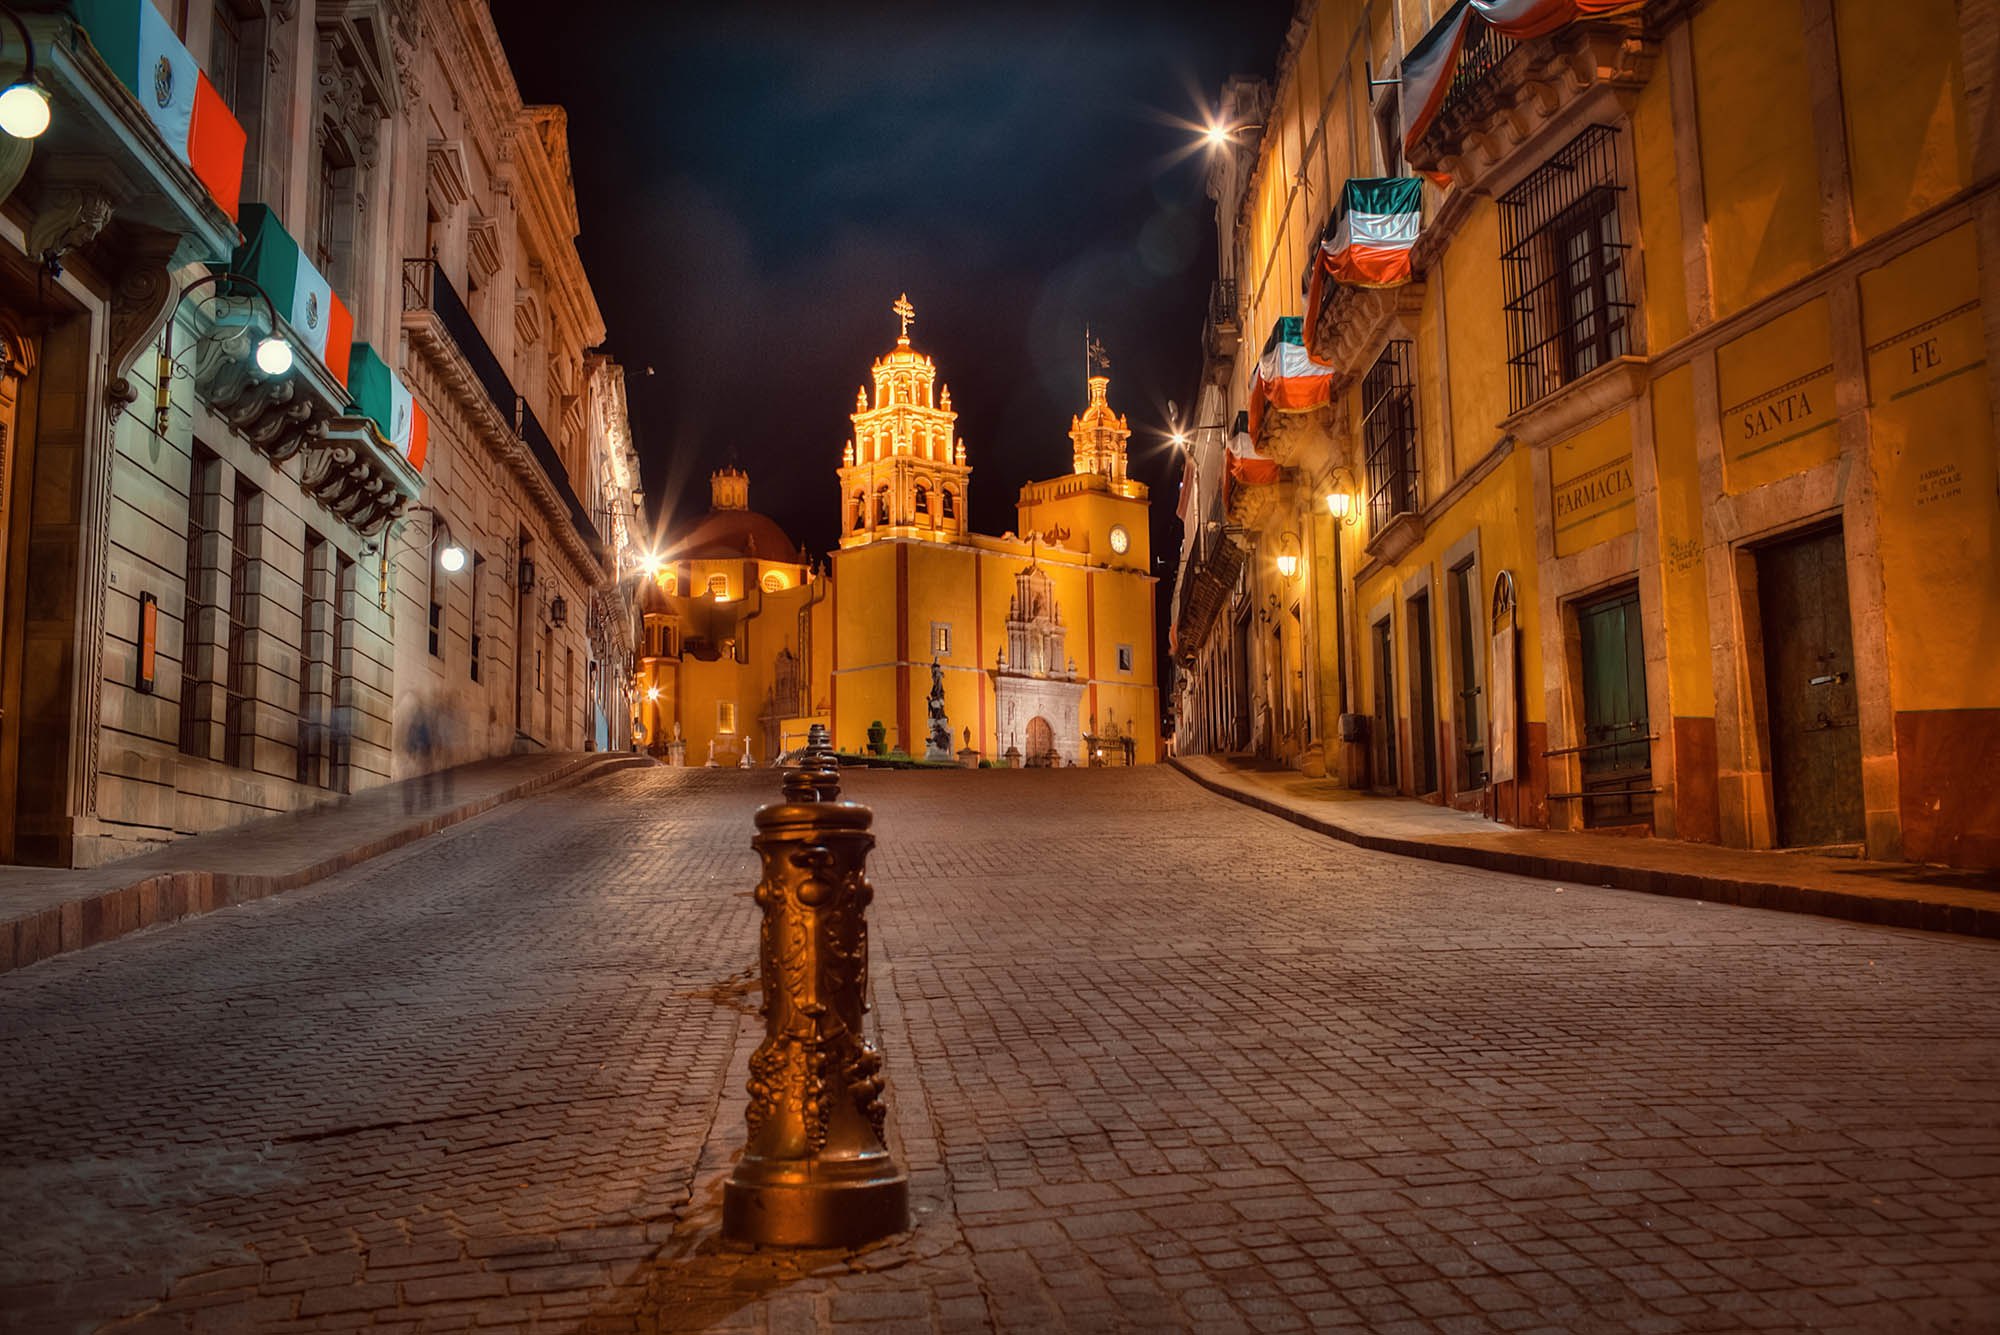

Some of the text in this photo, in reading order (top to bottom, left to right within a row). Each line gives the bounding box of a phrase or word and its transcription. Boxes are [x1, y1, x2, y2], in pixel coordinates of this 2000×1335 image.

[1910, 337, 1942, 375] FE
[1744, 391, 1814, 440] SANTA
[1557, 467, 1633, 517] FARMACIA
